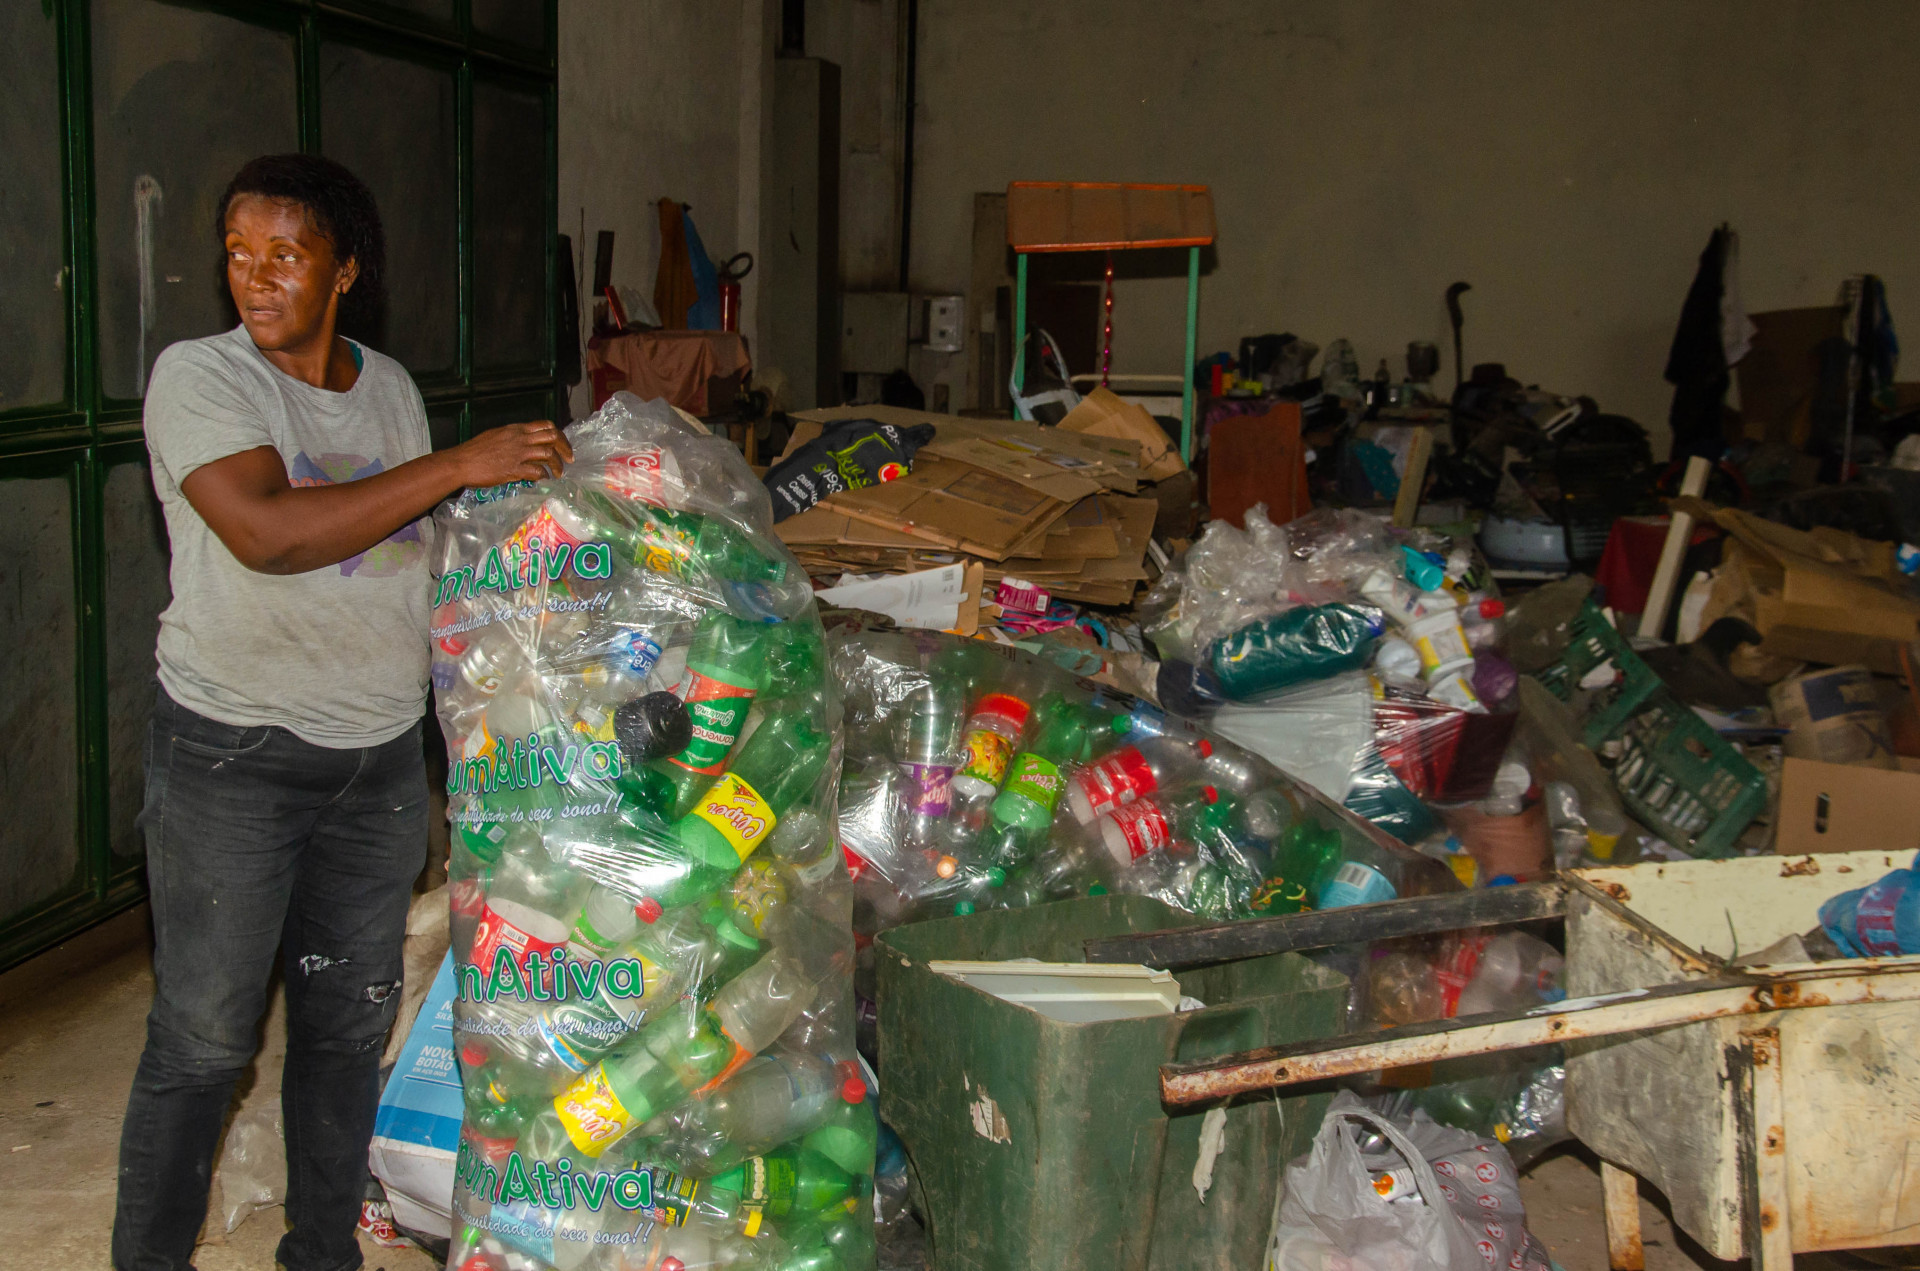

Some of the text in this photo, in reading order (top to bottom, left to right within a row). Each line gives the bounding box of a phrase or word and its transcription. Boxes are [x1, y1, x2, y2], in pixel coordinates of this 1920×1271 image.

[706, 802, 767, 840] Cliper
[517, 1016, 540, 1036] do
[416, 1057, 453, 1071] BOTÃO
[534, 1218, 555, 1239] do
[560, 1226, 588, 1243] seu
